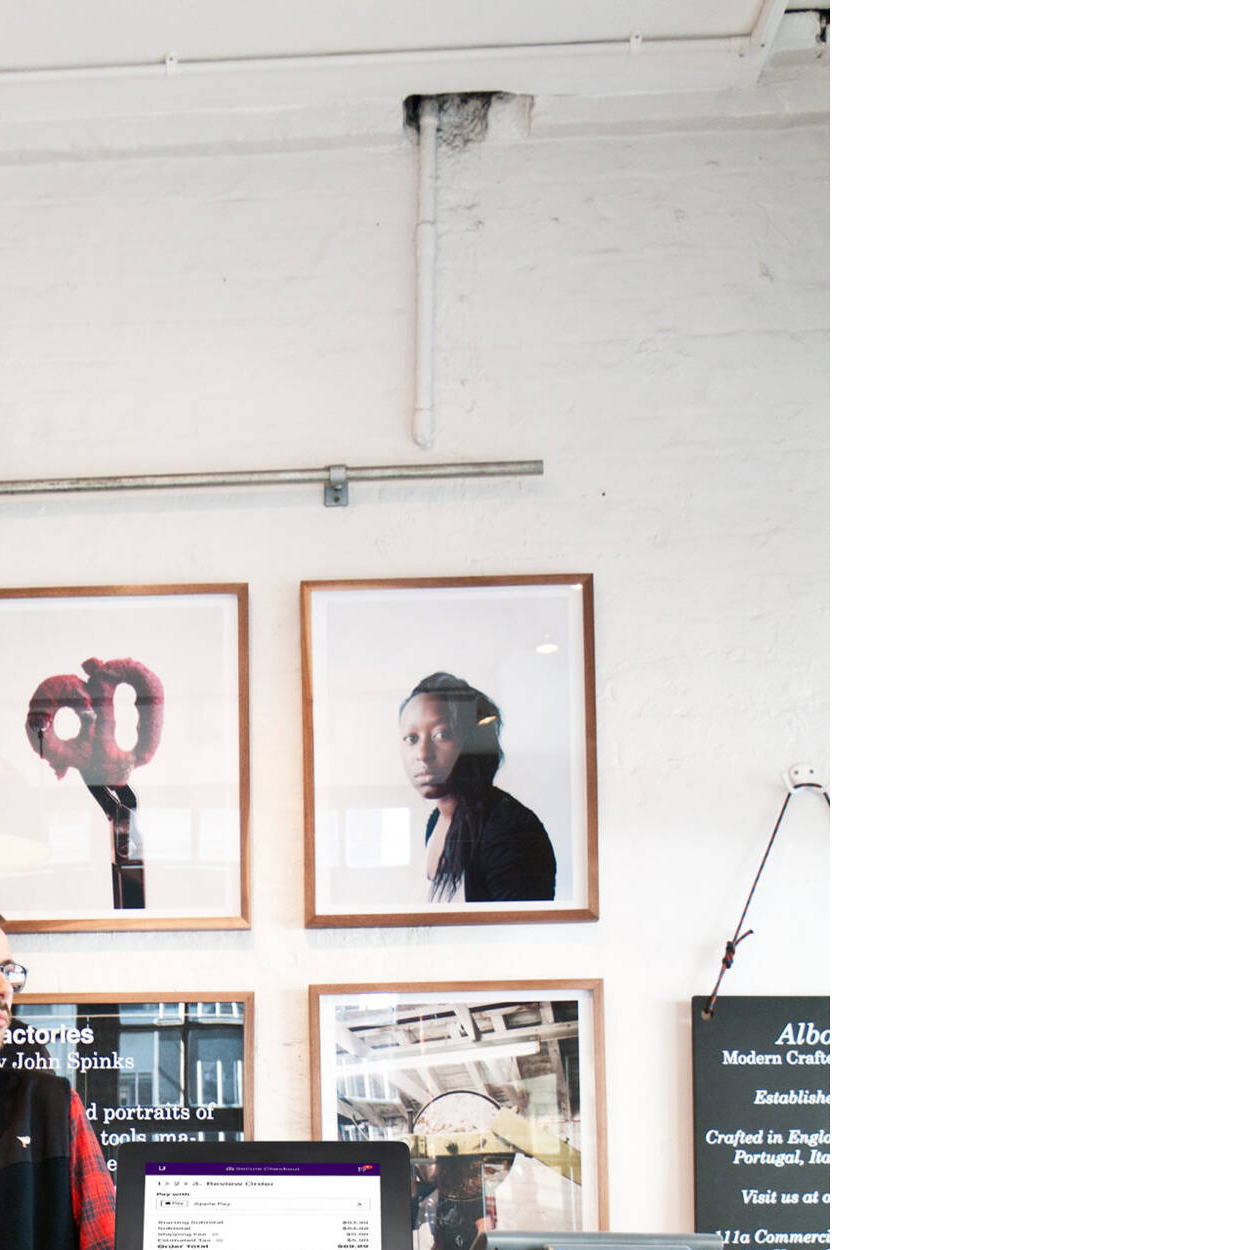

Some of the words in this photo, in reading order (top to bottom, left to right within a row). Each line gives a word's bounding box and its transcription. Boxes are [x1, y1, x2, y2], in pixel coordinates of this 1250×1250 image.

[3, 1024, 94, 1045] actories
[12, 1051, 63, 1070] John
[67, 1051, 135, 1073] Spinks
[722, 1050, 782, 1065] Modern
[103, 1103, 190, 1124] portraits
[196, 1102, 215, 1120] of
[100, 1128, 147, 1146] tools
[705, 1129, 764, 1147] Crafted
[767, 1130, 783, 1144] in
[733, 1149, 804, 1167] Portugal,
[741, 1188, 777, 1204] Visit
[780, 1192, 799, 1204] us
[802, 1190, 819, 1204] at
